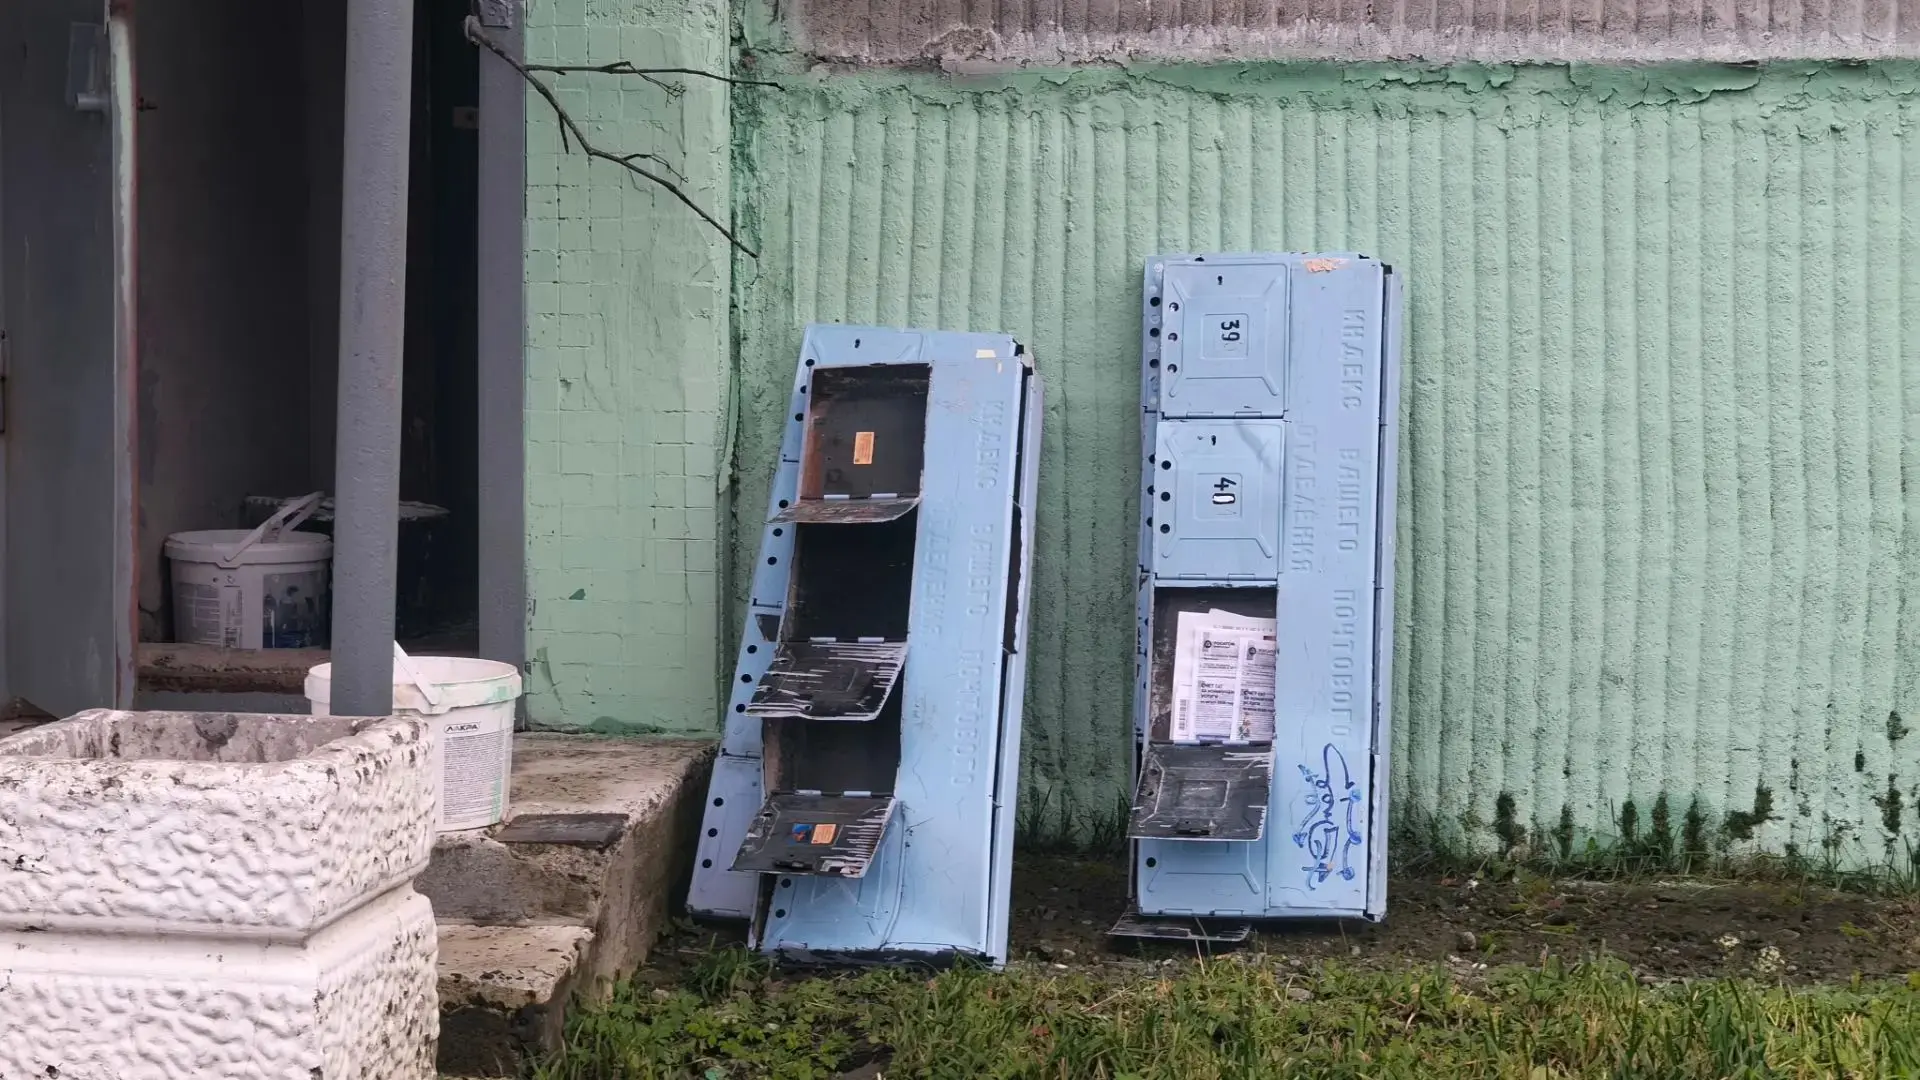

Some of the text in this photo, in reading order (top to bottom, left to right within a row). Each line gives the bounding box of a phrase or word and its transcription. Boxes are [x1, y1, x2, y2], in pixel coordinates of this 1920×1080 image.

[1220, 319, 1240, 342] 39
[1212, 476, 1237, 504] 40
[1290, 424, 1317, 574] ОТДЕЛЕНИЯ
[1331, 308, 1365, 737] ИНДЕКС ВАШЕГО ПОЧТОВОГО
[951, 400, 1004, 788] ИНДЕКС ВАШЕГО ПОЧТОВОГО
